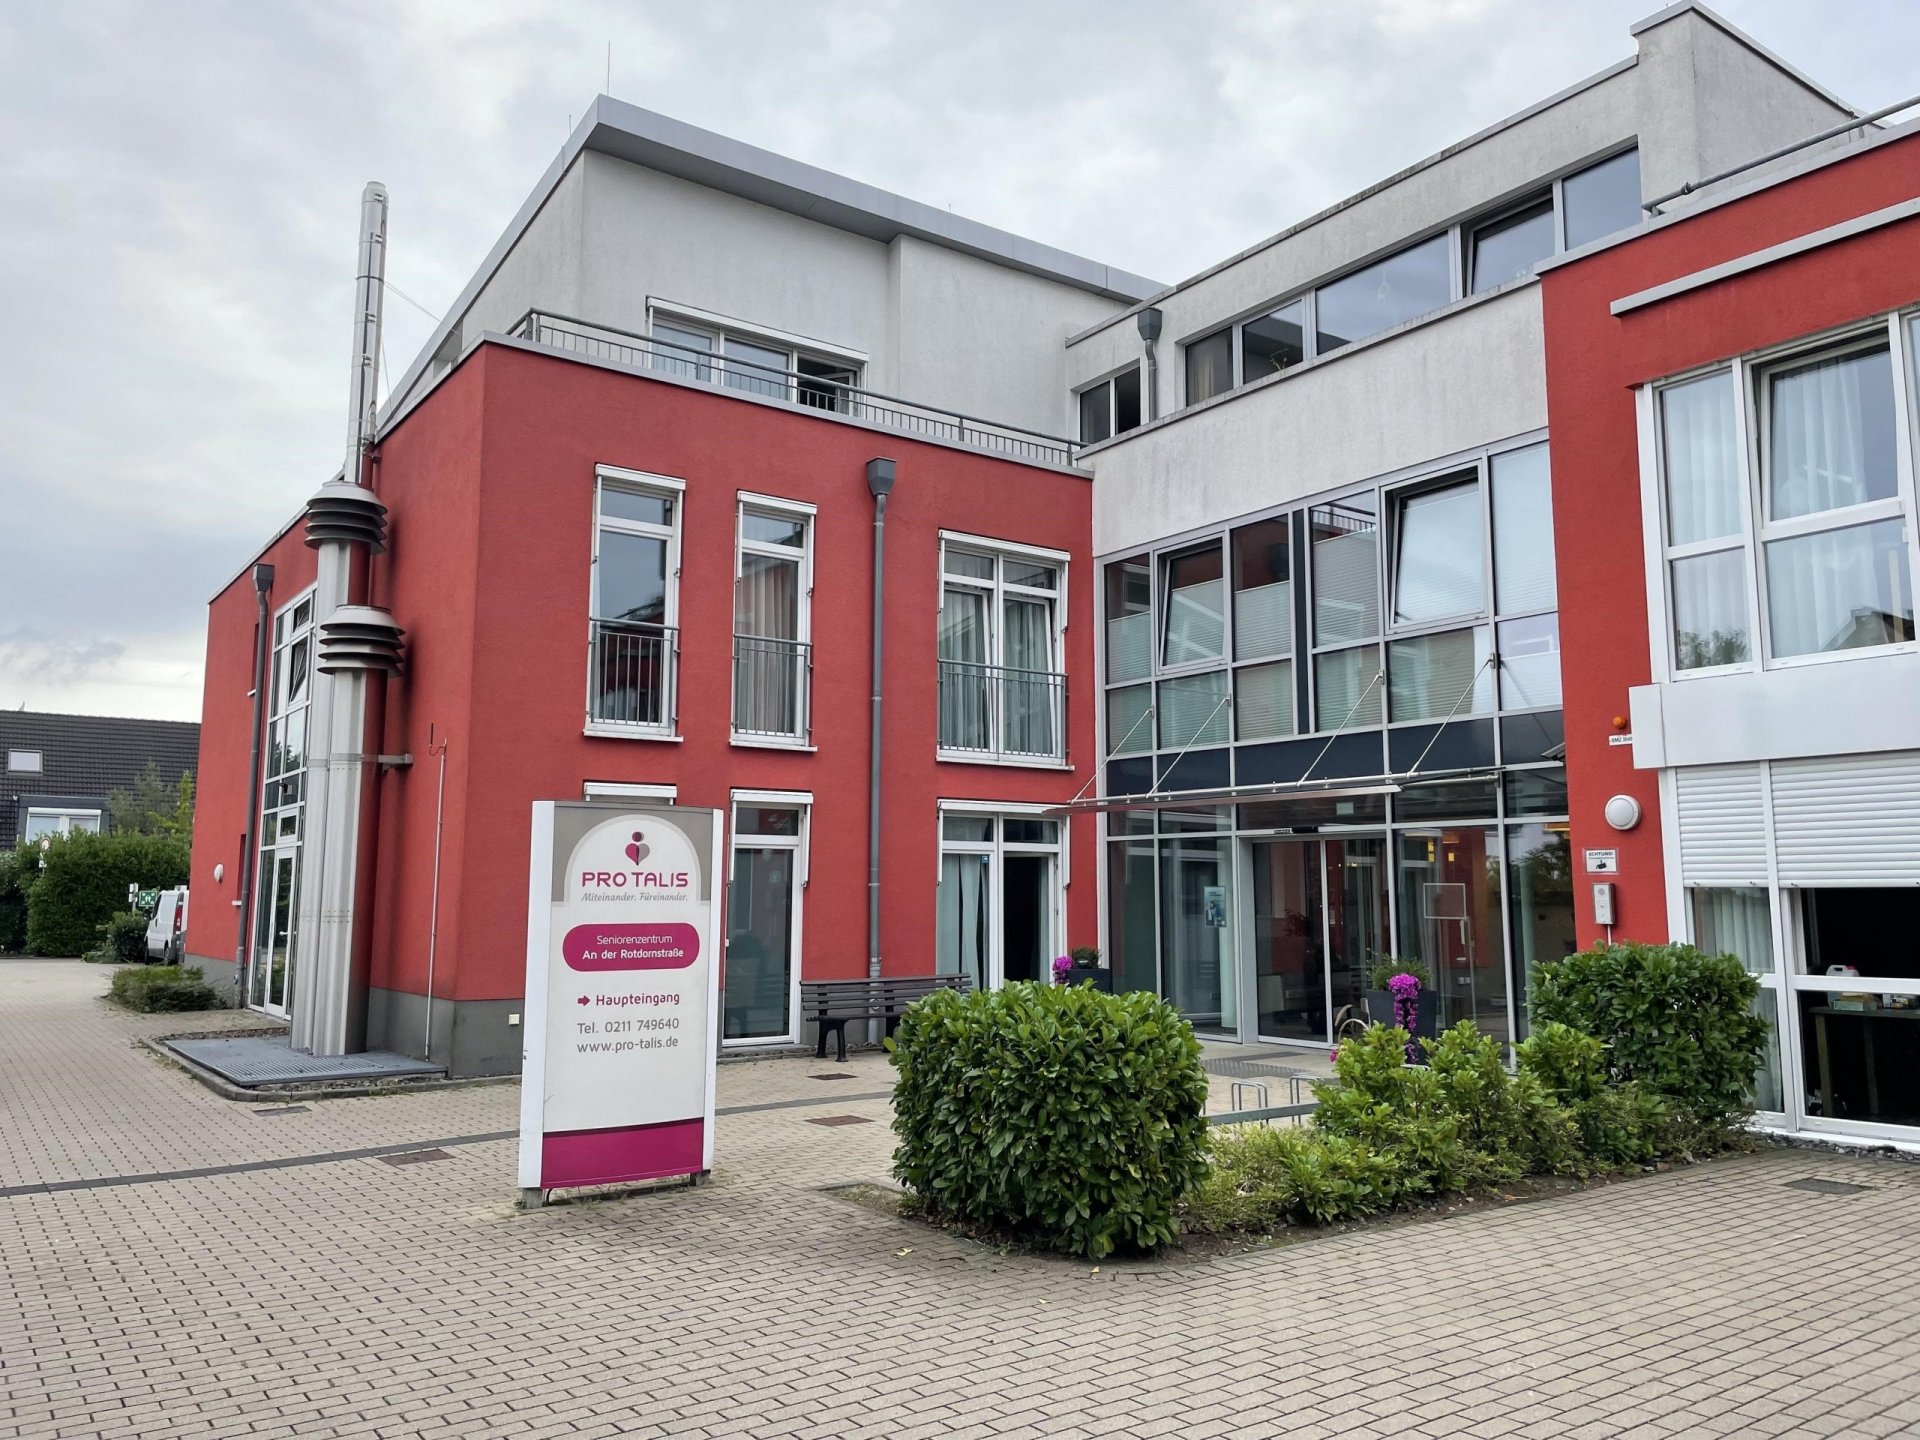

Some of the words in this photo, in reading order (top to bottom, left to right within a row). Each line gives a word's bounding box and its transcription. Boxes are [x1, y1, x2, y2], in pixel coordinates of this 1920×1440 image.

[582, 872, 627, 887] PRO
[631, 872, 688, 887] TALIS
[581, 892, 637, 901] Miteinander.
[639, 892, 688, 901] Füreinander.
[596, 935, 673, 945] Seniorenzentrum
[582, 950, 597, 960] An
[601, 950, 617, 959] der
[620, 948, 684, 959] Rotdornstraße
[596, 993, 680, 1008] Haupteingang
[577, 1022, 599, 1034] Tel.
[604, 1021, 631, 1033] 0211
[637, 1018, 680, 1031] 749640
[577, 1036, 679, 1053] www.pro-talis.de
